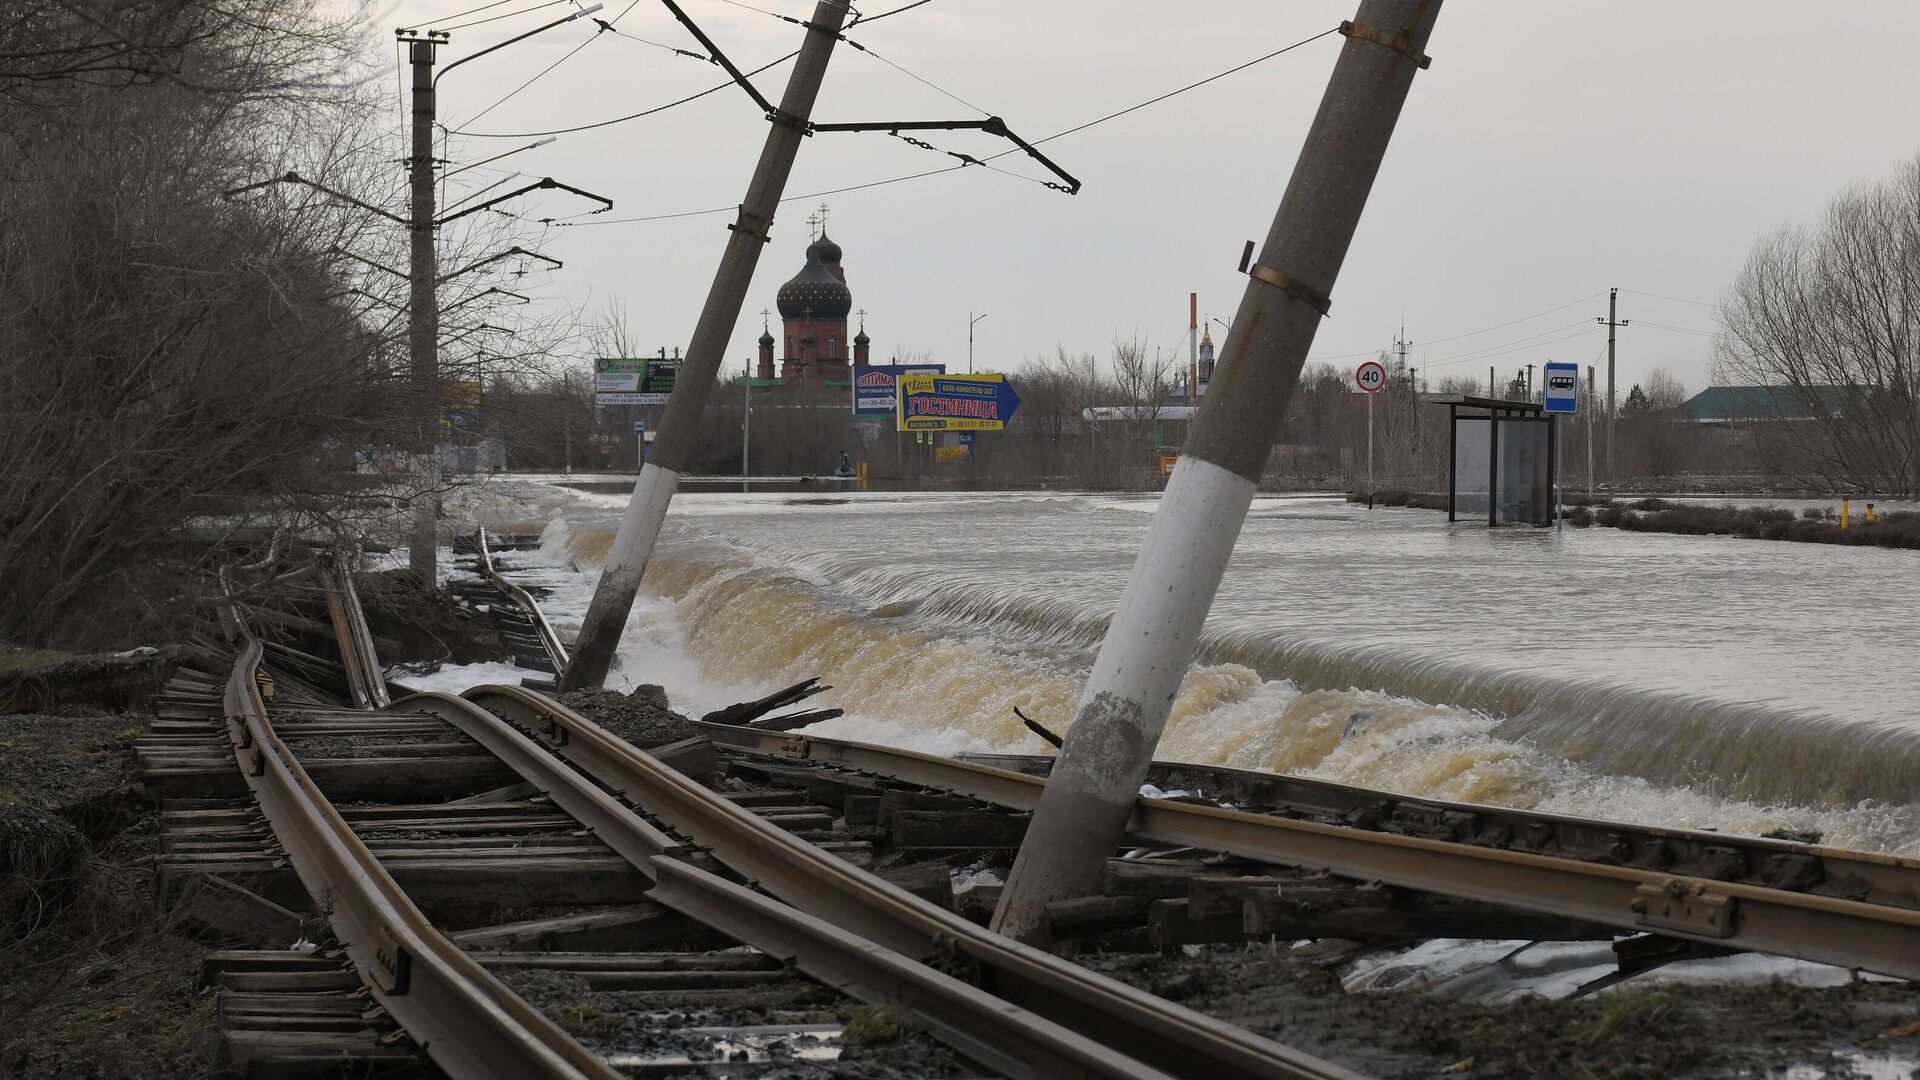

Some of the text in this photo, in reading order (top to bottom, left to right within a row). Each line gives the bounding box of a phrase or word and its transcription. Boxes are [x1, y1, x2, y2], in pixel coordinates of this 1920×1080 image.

[856, 371, 895, 387] ОПТИМА
[1361, 370, 1379, 383] 40
[908, 397, 997, 419] ГОСТИНИЦА
